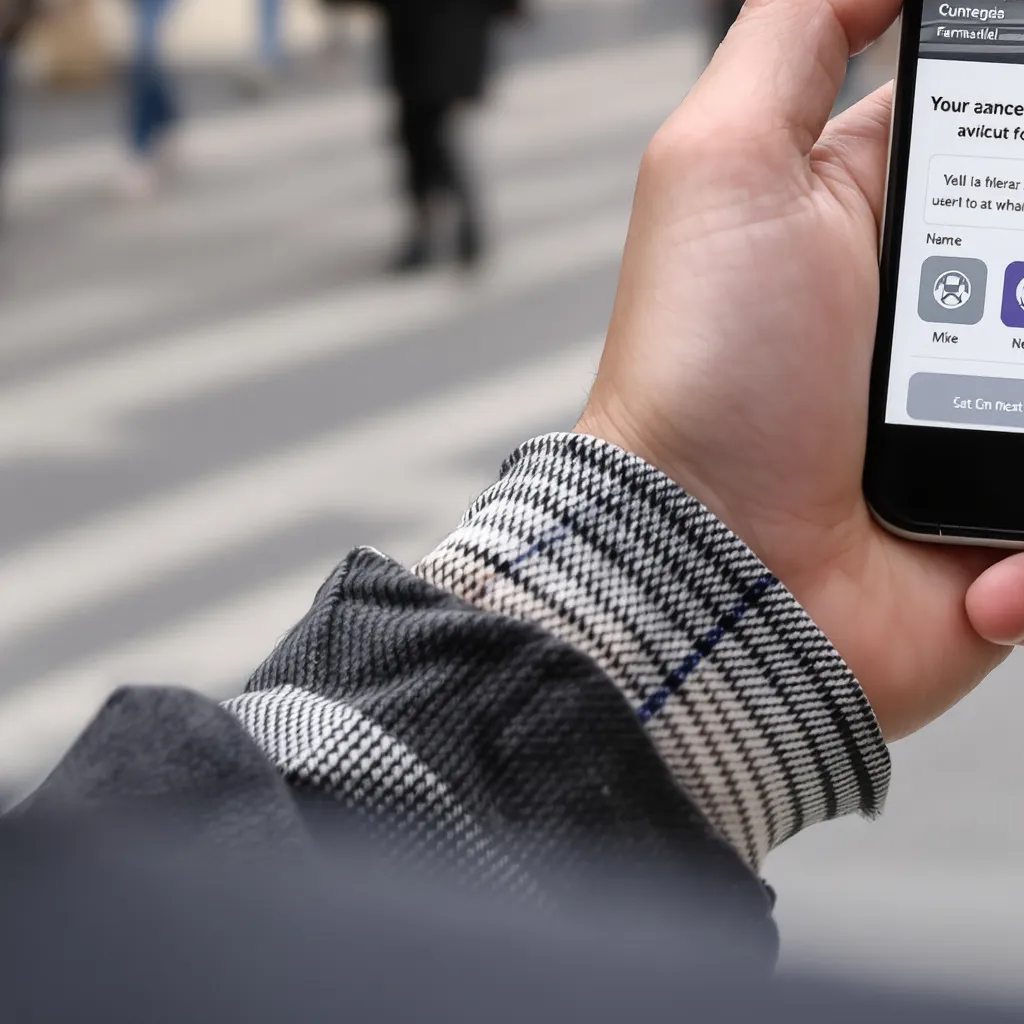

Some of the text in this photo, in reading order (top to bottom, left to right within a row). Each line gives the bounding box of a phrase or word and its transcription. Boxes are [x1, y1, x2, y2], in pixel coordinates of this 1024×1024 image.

[930, 95, 970, 113] Your
[966, 197, 977, 209] to
[980, 199, 993, 210] at
[925, 232, 963, 246] Name
